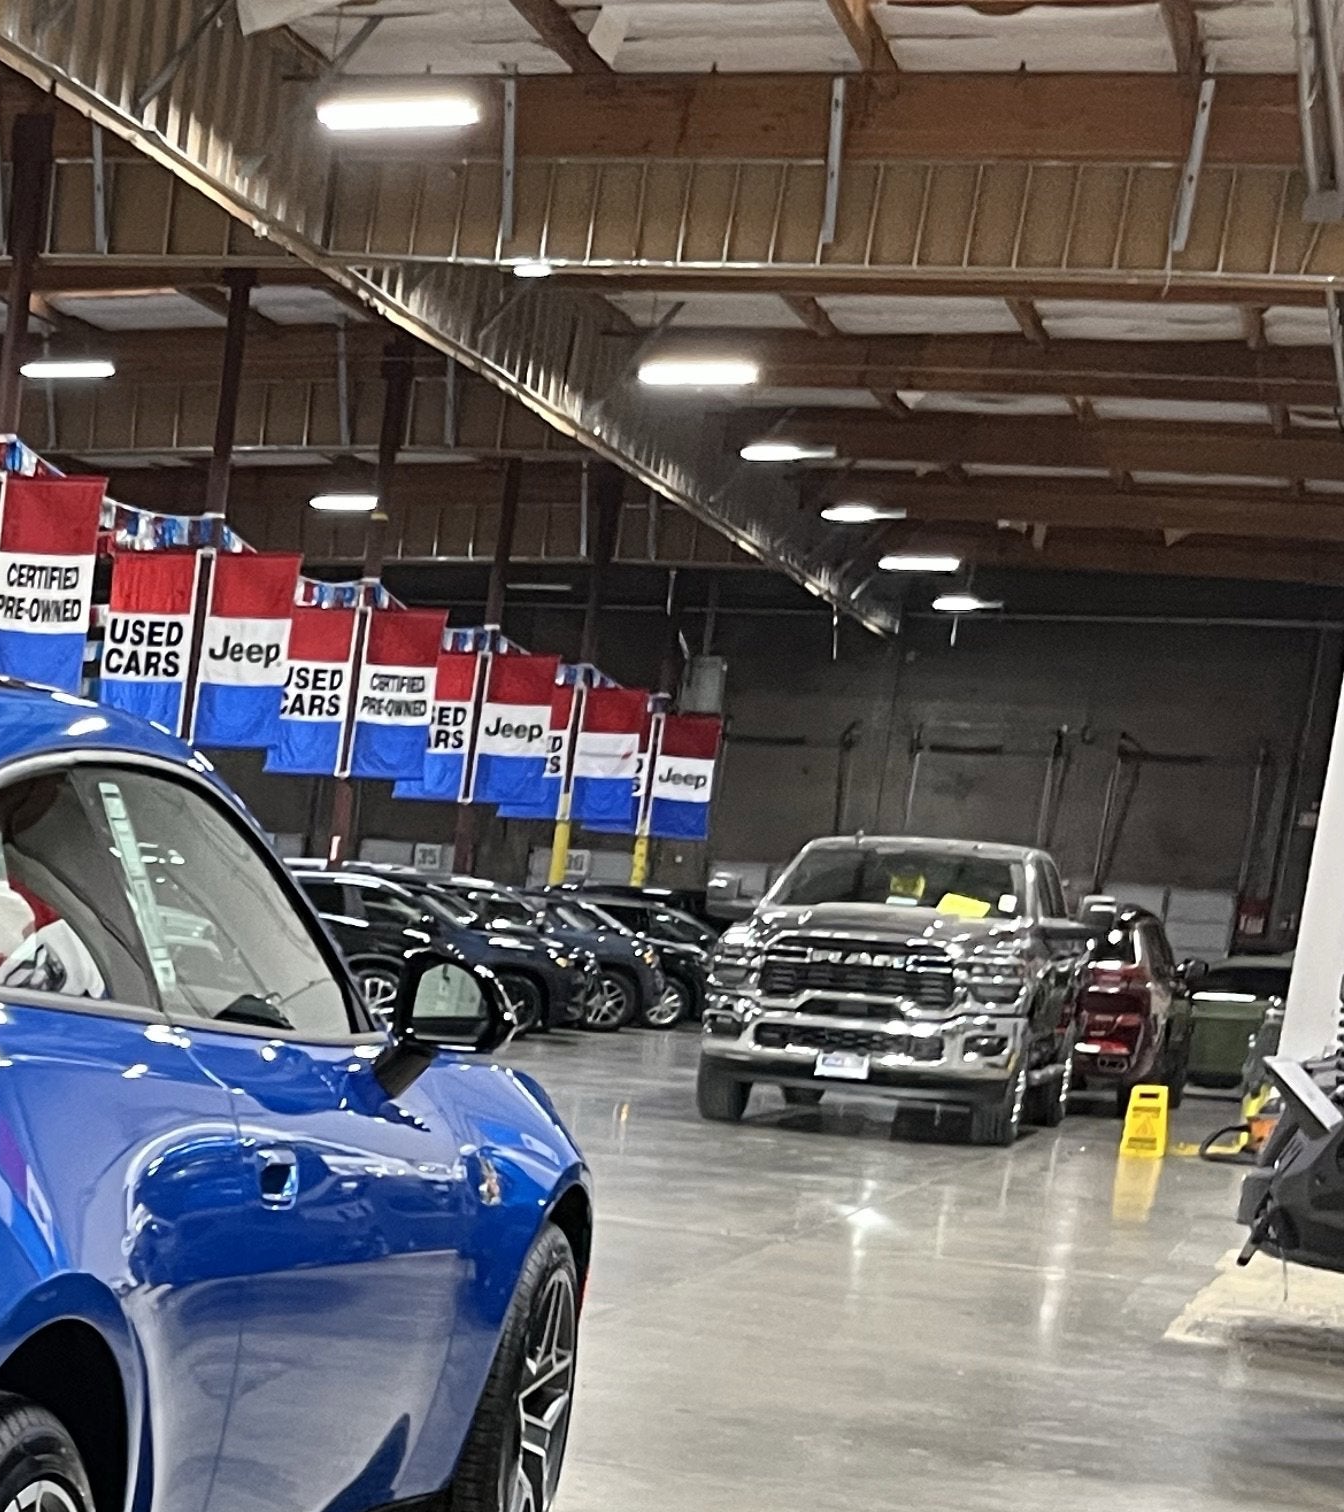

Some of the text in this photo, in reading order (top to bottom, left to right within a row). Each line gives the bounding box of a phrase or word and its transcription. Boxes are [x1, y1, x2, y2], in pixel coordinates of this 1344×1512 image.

[6, 562, 80, 591] CERTIFIED
[109, 618, 184, 647] USED
[105, 648, 180, 677] CARS
[208, 635, 280, 668] Jeep
[484, 716, 544, 742] Jeep
[658, 767, 708, 790] Jeep
